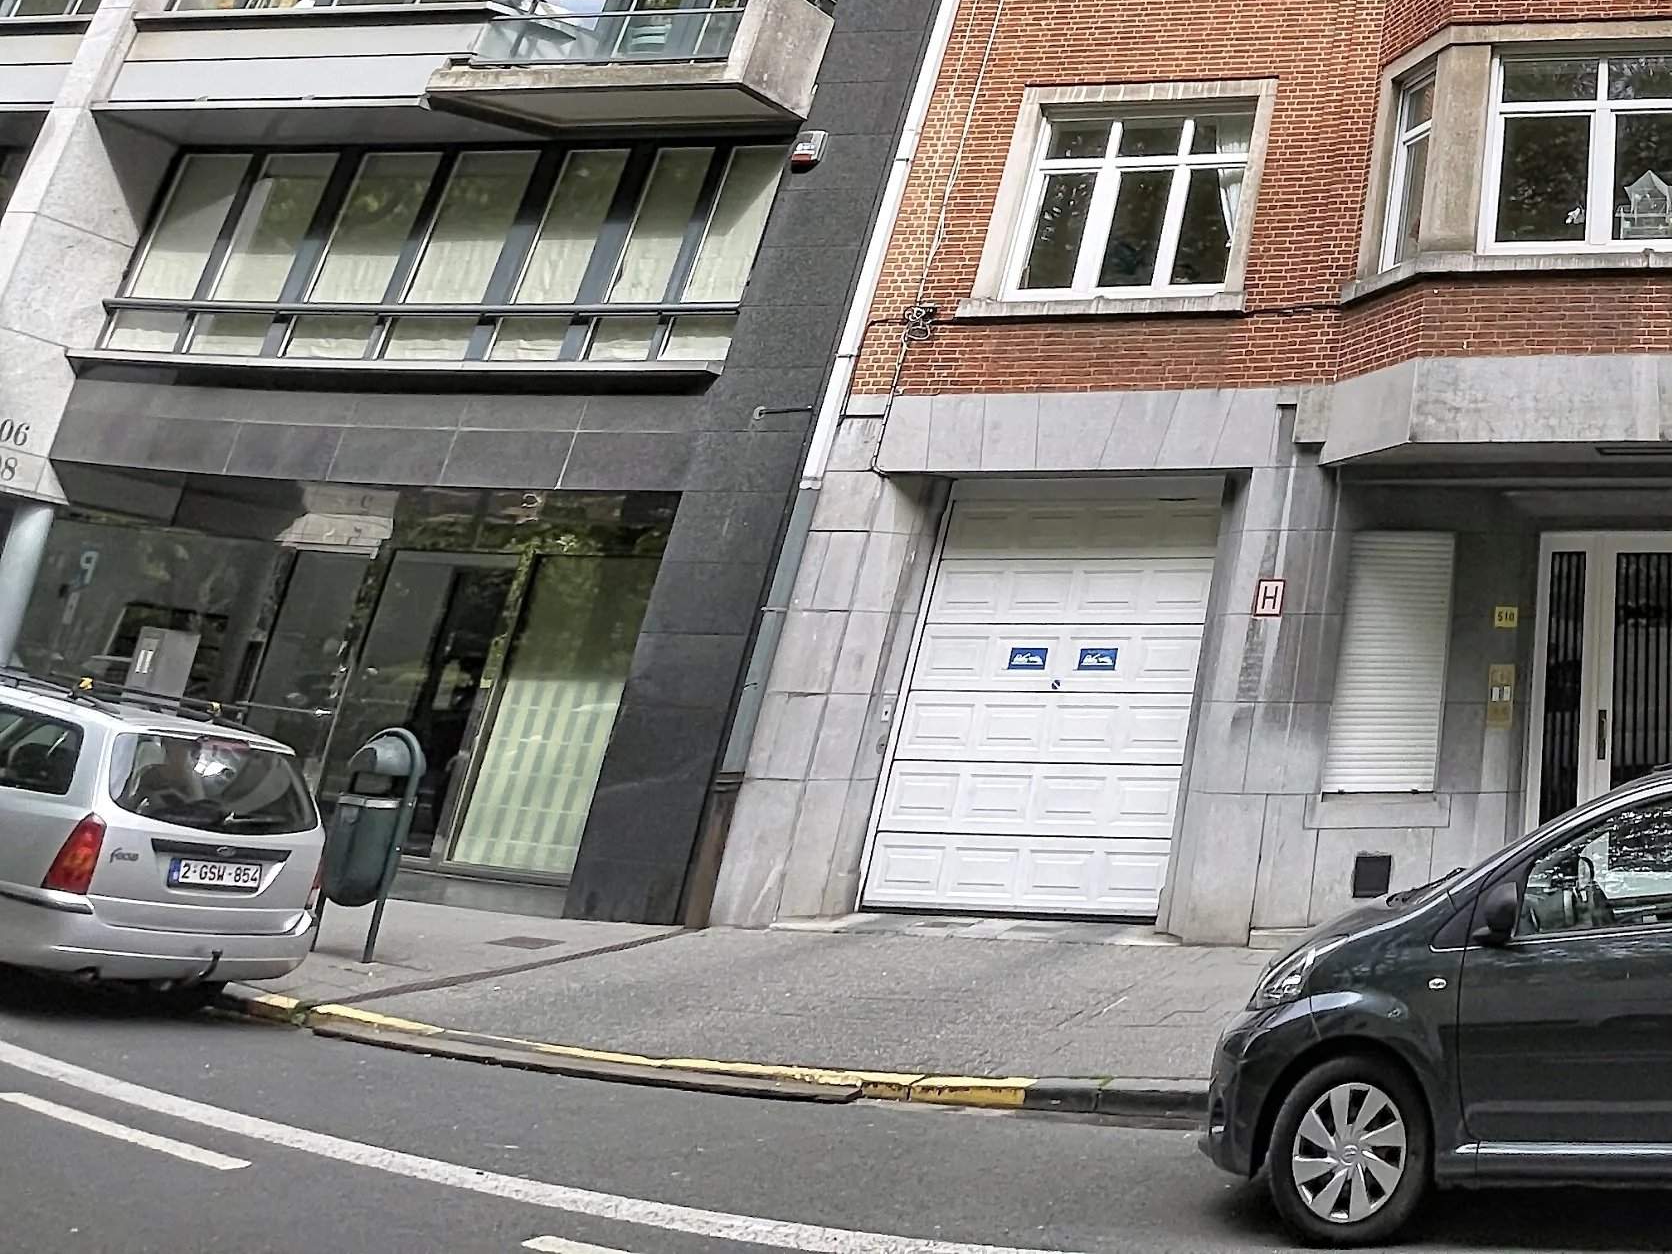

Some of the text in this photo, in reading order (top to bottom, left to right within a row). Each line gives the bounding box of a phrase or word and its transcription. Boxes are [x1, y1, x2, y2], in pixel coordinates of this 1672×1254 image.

[0, 457, 18, 481] 8
[1261, 585, 1279, 610] H
[1497, 611, 1515, 622] 510
[181, 862, 259, 884] 2-GSW-854
